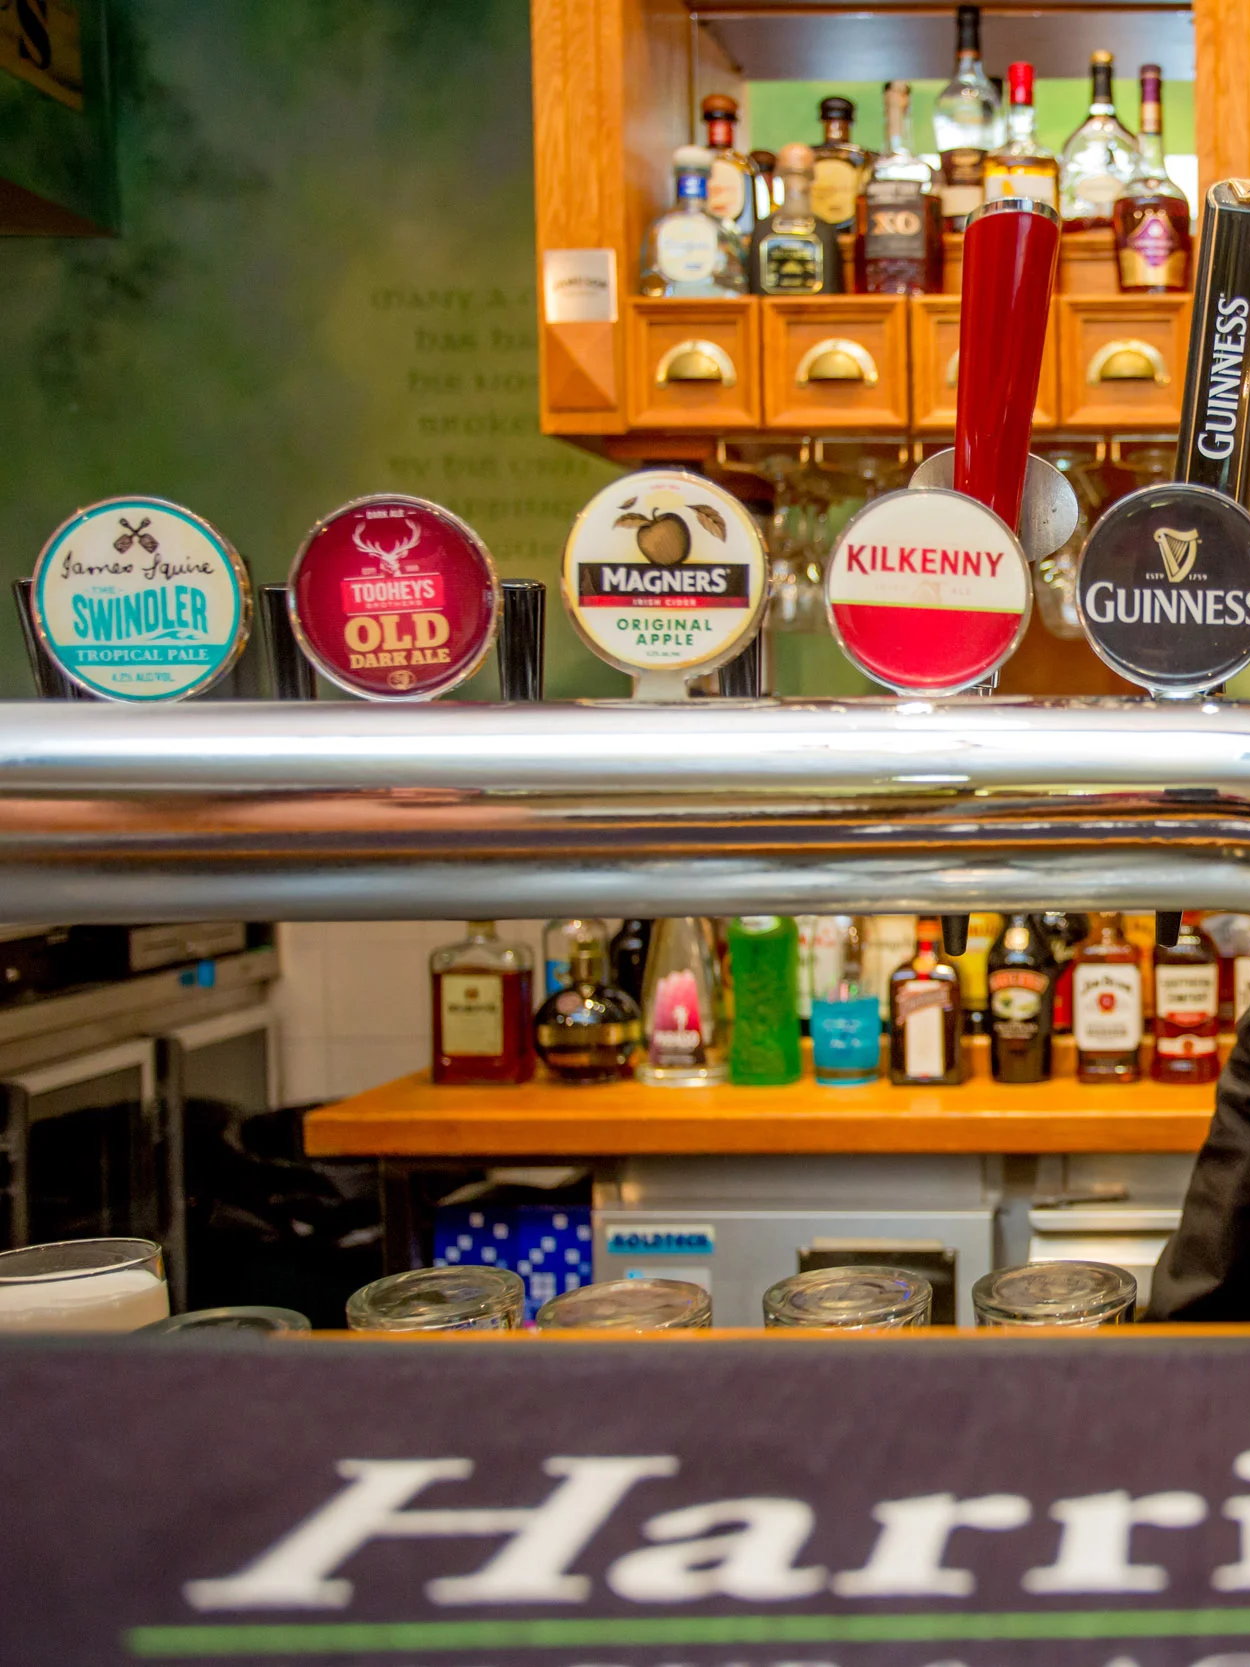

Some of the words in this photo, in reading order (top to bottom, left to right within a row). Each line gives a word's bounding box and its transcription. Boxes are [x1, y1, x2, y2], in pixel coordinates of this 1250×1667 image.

[872, 210, 921, 236] XO
[1198, 298, 1249, 460] GUINNESS
[61, 550, 134, 579] James
[142, 553, 215, 580] Squire
[846, 544, 1005, 578] KILKENNY
[602, 567, 728, 594] MAGNERS
[1188, 573, 1208, 581] 1759
[351, 579, 436, 604] TOOHEYS
[632, 598, 661, 607] IRISH
[665, 598, 697, 607] CIDER
[72, 584, 209, 642] SWINDLER
[616, 618, 713, 632] ORIGINAL
[344, 612, 450, 653] OLD
[636, 634, 694, 646] APPLE
[76, 649, 163, 663] TROPICAL
[167, 648, 210, 662] PALE
[350, 653, 409, 669] DARK
[410, 649, 451, 666] ALE
